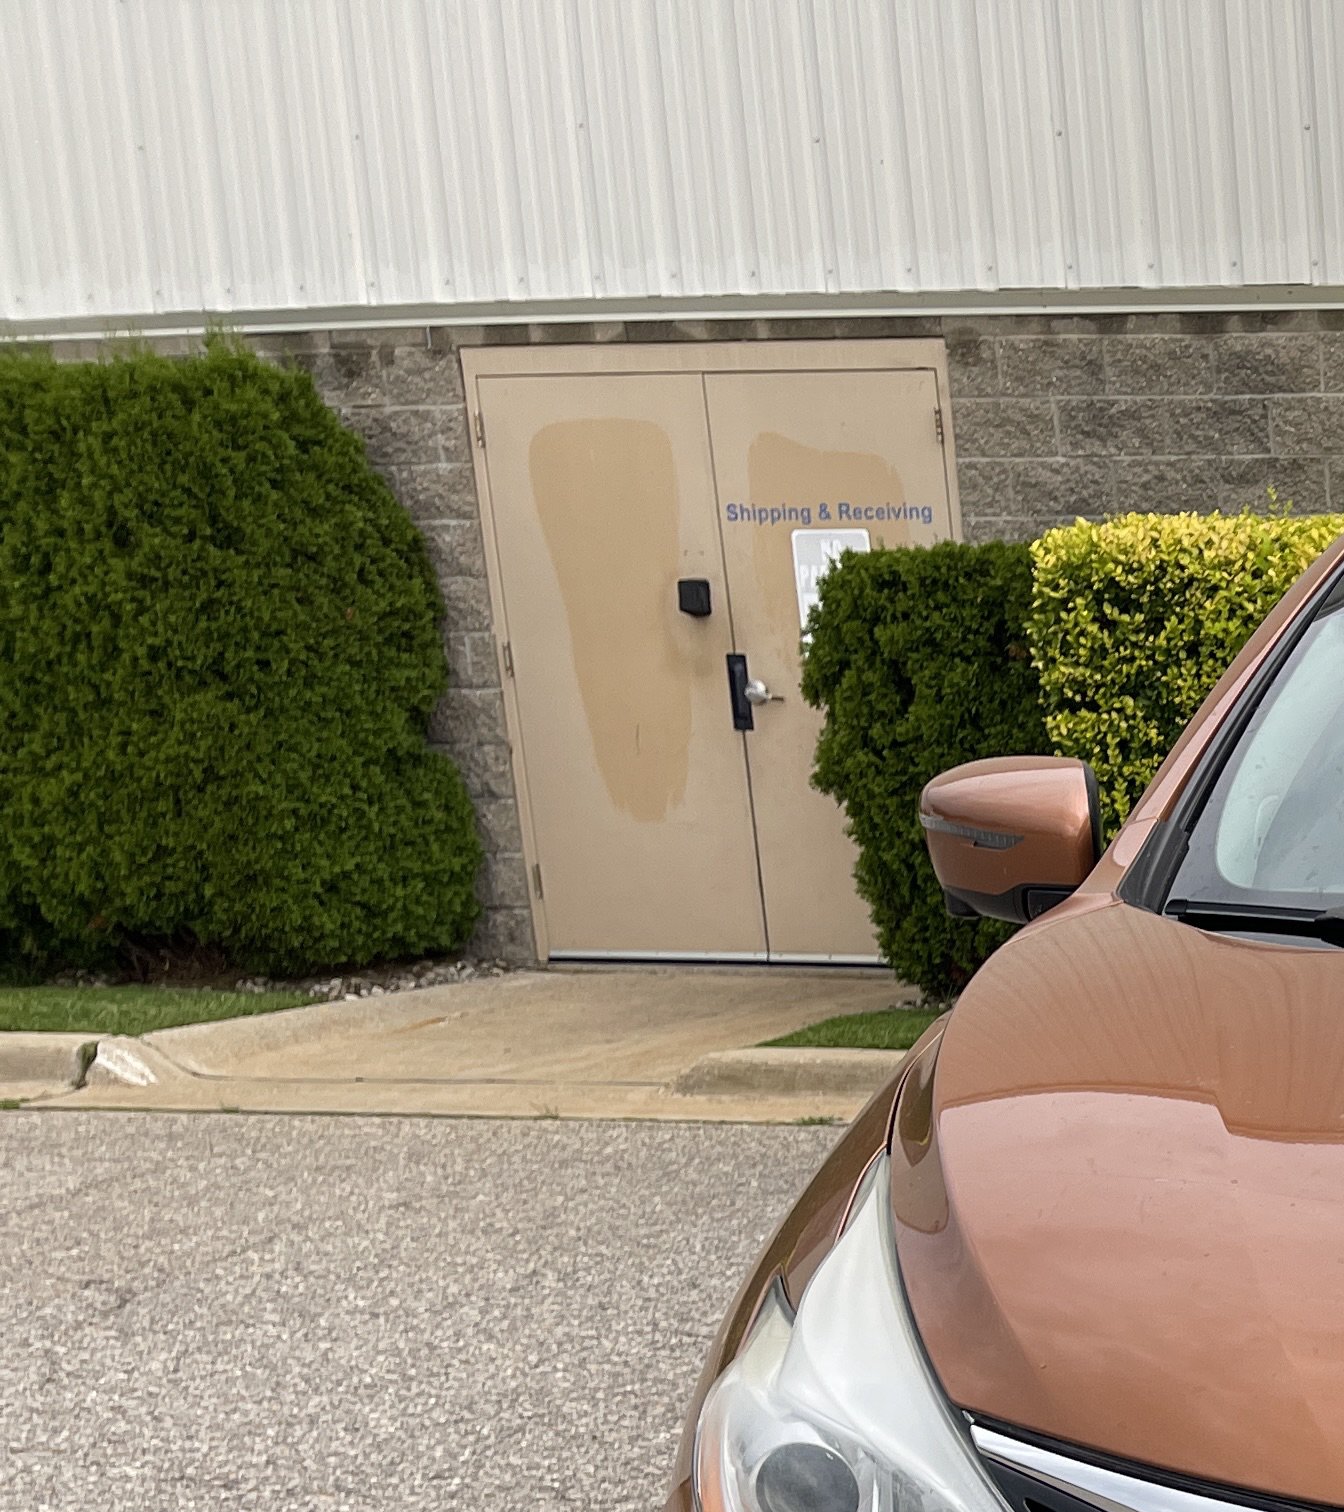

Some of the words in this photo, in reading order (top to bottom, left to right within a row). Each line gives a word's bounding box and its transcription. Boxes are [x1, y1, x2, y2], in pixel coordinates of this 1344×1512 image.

[726, 503, 811, 525] Shipping
[818, 503, 832, 520] &
[837, 503, 933, 524] Receiving
